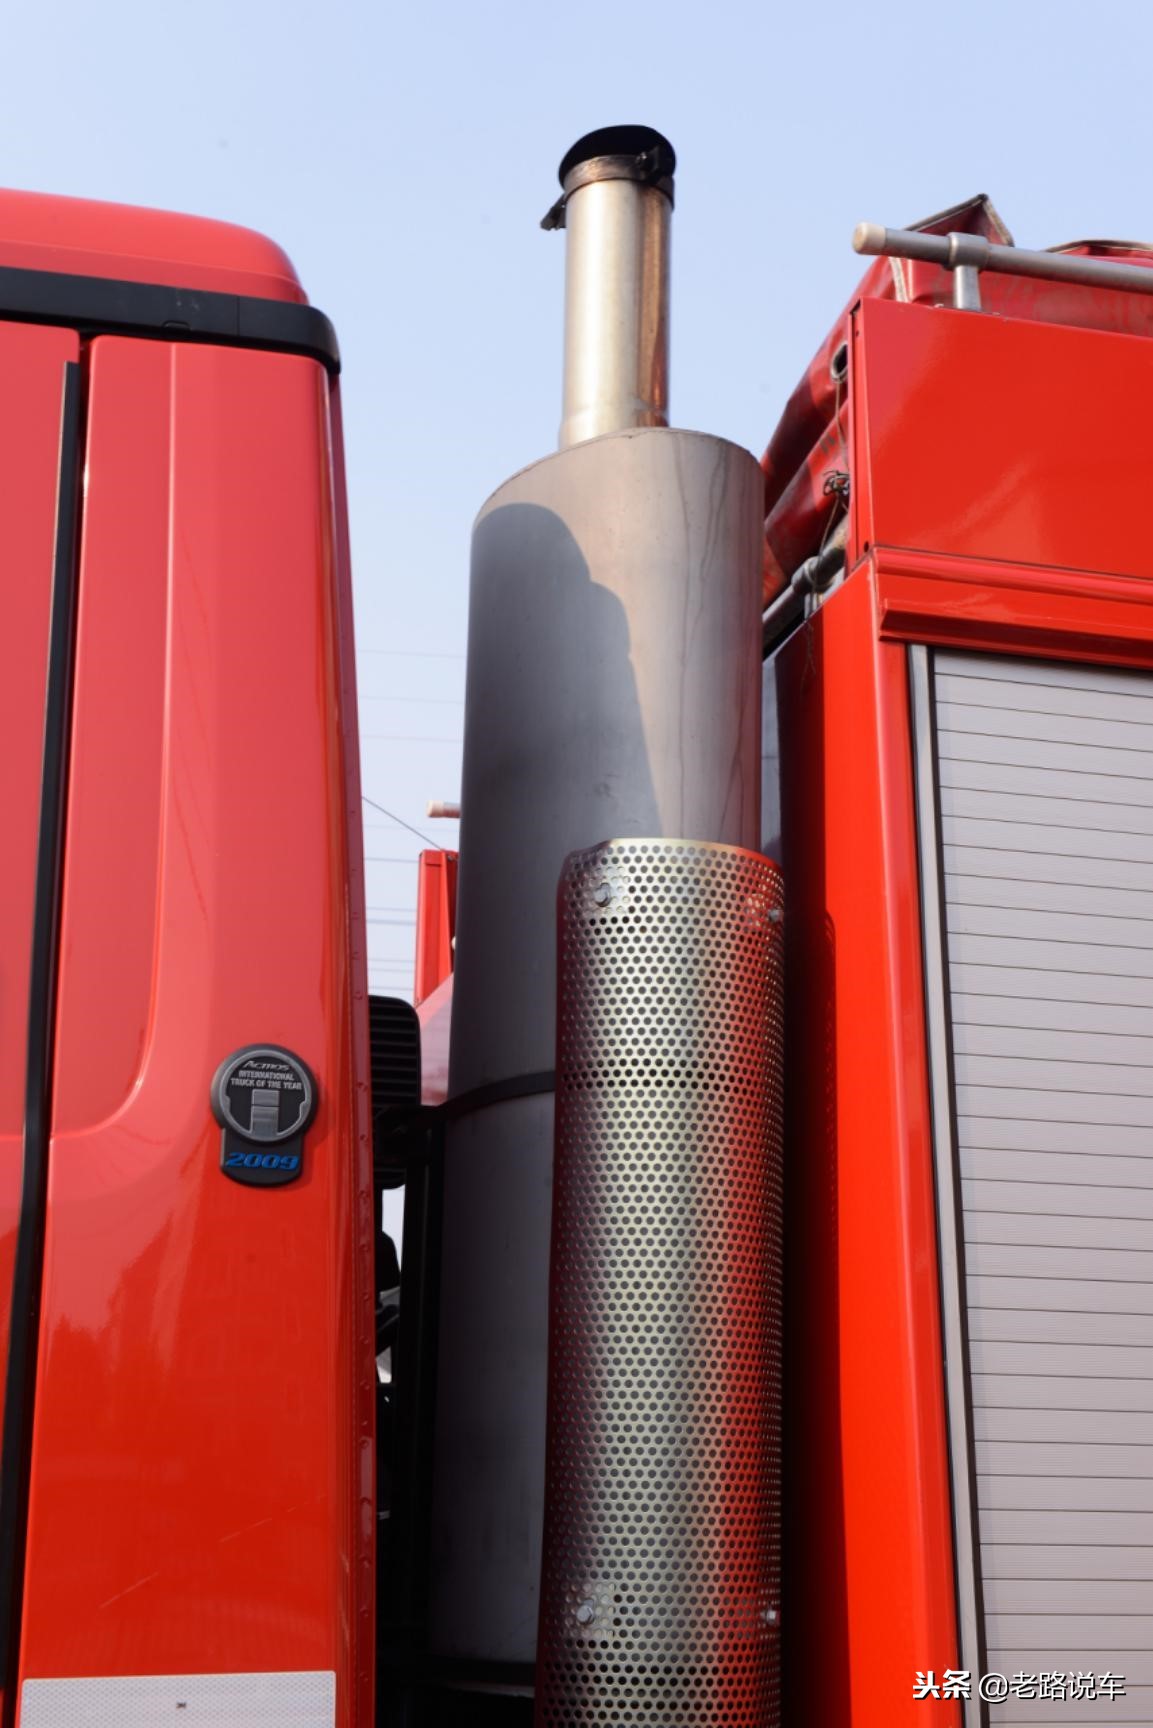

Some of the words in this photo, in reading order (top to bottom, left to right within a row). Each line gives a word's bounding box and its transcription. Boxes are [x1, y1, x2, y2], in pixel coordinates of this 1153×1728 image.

[239, 1071, 294, 1081] INTERNATIONAL
[231, 1078, 255, 1087] TRUCK
[256, 1079, 266, 1088] OF
[267, 1080, 281, 1089] THE
[283, 1081, 302, 1090] YEAR
[226, 1152, 298, 1170] 2009
